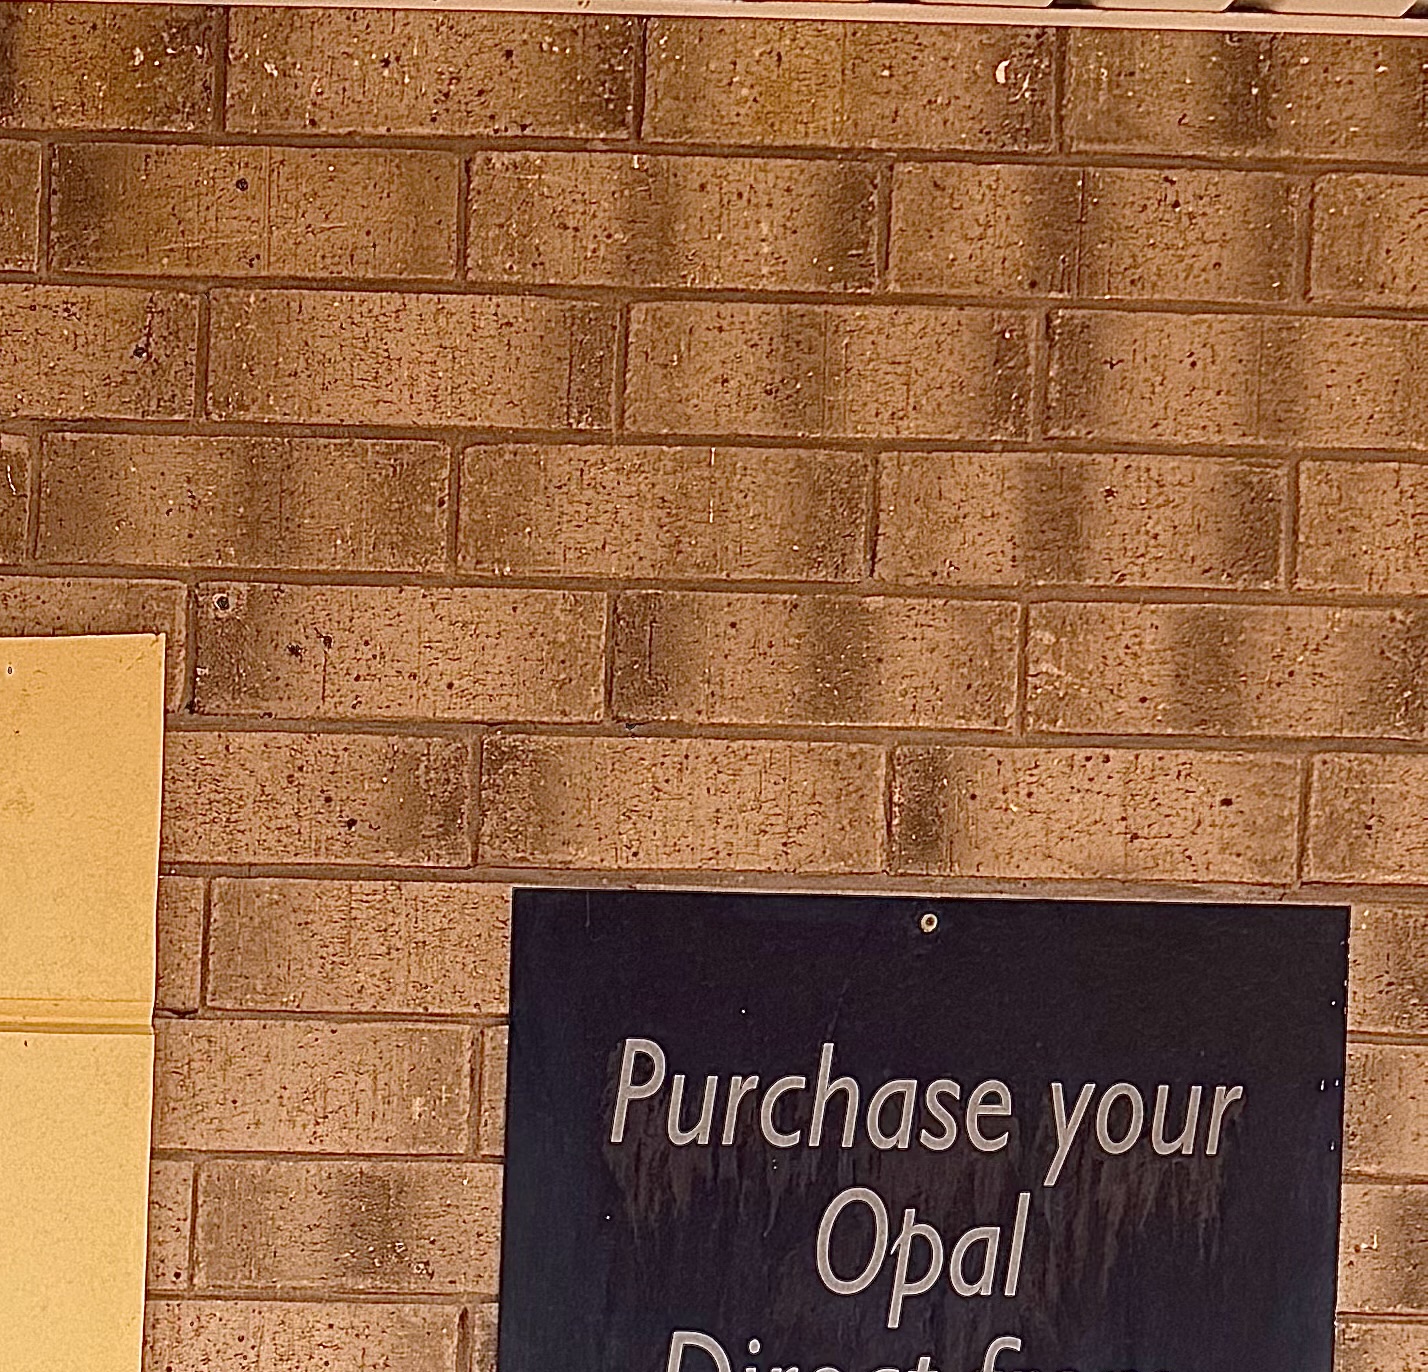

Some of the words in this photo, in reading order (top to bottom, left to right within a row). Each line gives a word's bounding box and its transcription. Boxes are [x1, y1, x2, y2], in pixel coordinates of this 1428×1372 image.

[609, 1038, 1013, 1152] Purchase
[1043, 1081, 1244, 1187] your
[816, 1186, 1032, 1330] Opal
